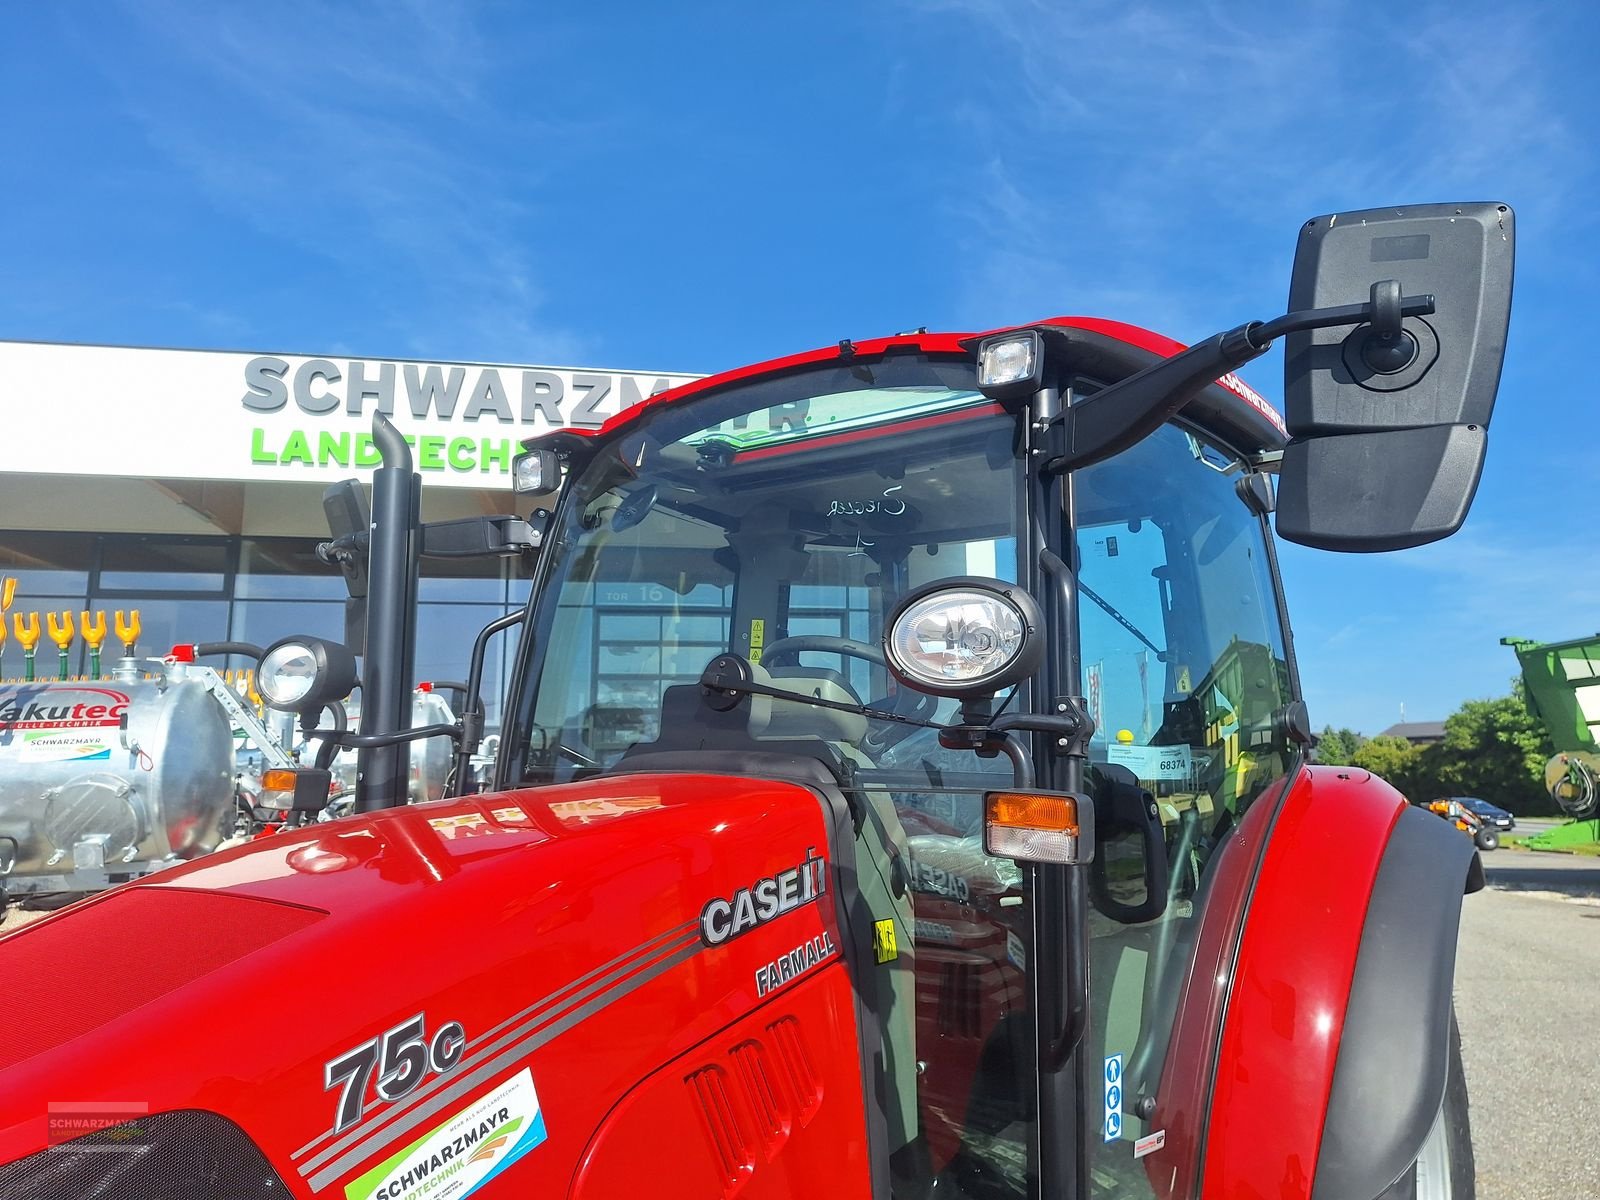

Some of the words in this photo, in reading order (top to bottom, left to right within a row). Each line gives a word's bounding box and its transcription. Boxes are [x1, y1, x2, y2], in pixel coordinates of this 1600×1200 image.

[606, 592, 629, 601] TOR
[639, 585, 664, 602] 16
[30, 737, 102, 746] SCHWARZMAYR
[1160, 759, 1186, 771] 68374
[701, 868, 800, 947] CASE
[755, 931, 836, 998] FARMALL
[376, 1107, 510, 1200] SCHWARZMAYR
